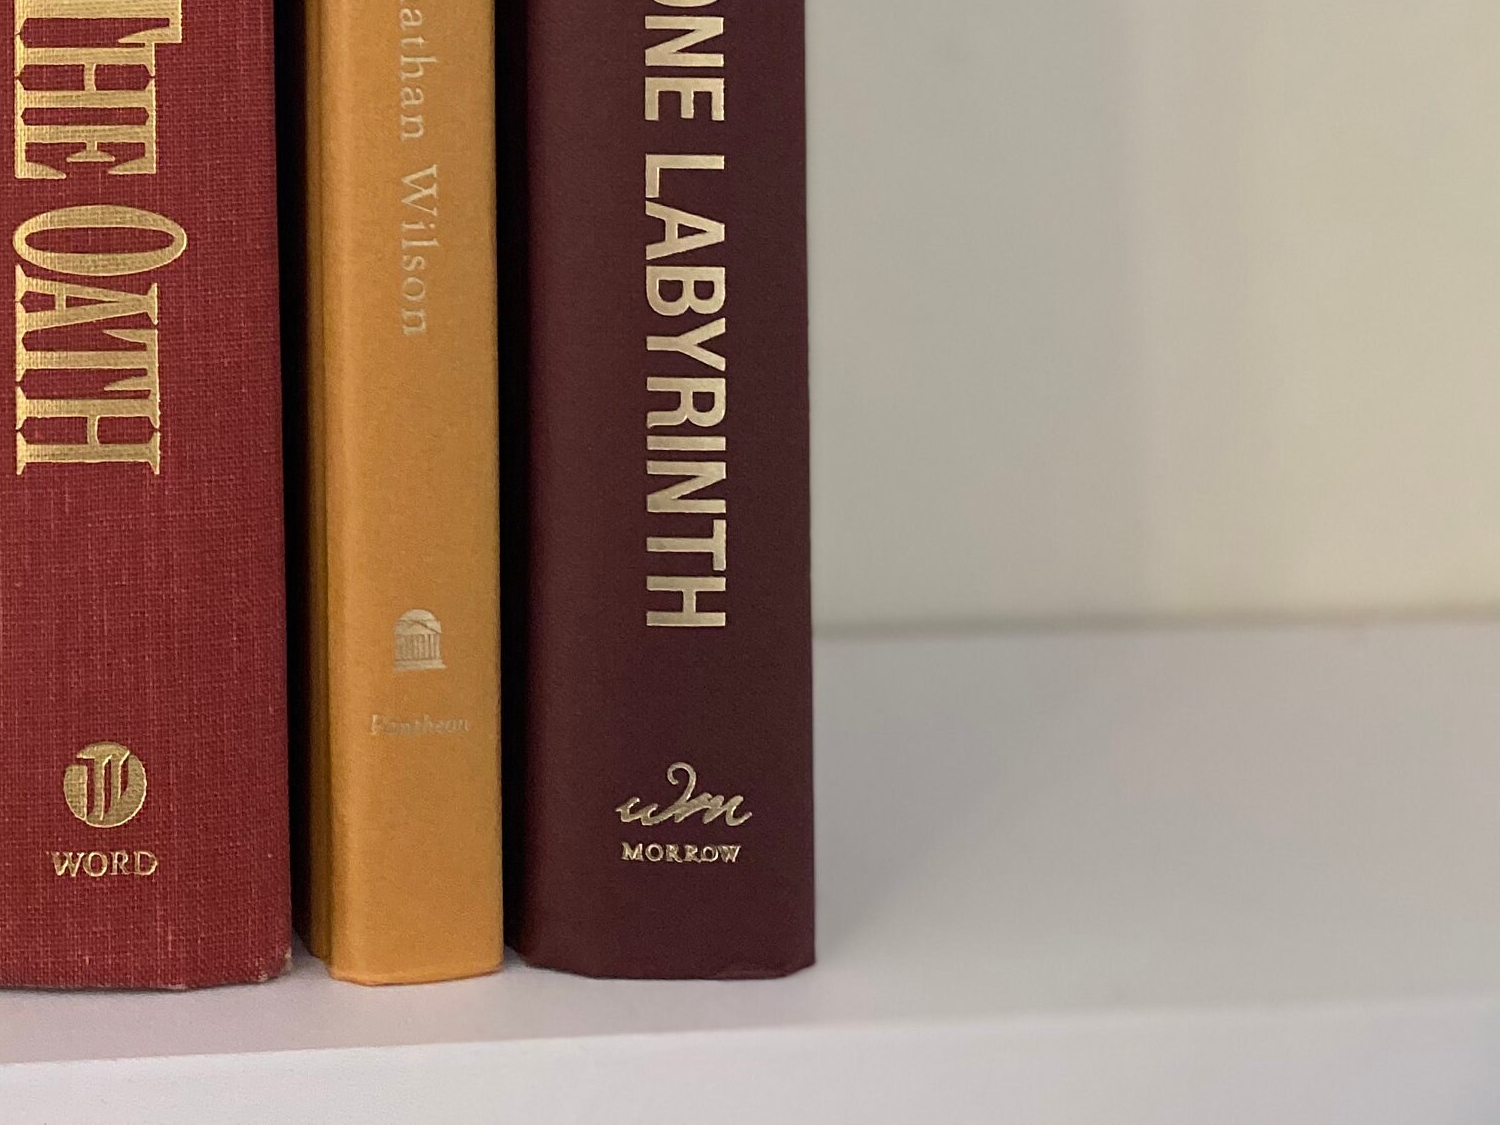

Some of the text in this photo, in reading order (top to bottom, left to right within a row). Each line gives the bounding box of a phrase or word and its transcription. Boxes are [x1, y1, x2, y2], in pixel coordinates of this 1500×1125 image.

[401, 164, 439, 335] Wilson
[12, 204, 188, 475] OATH
[645, 154, 727, 627] LABYRINTH
[48, 850, 159, 877] WORD
[622, 843, 741, 863] MORROW
